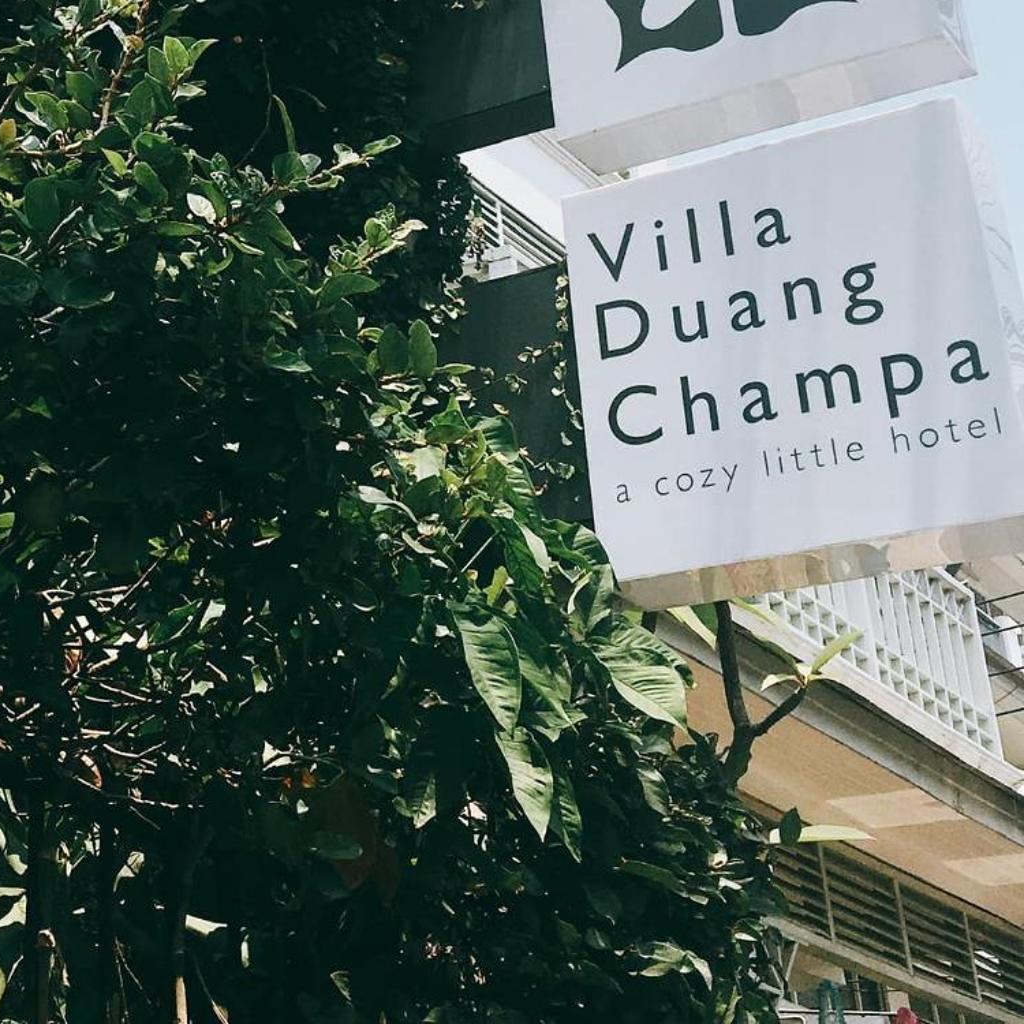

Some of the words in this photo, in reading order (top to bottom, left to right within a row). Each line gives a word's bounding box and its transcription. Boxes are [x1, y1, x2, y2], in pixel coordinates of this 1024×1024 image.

[587, 199, 792, 283] Villa
[594, 261, 885, 361] Duang
[607, 339, 990, 446] Champa
[615, 483, 631, 504] a
[654, 463, 739, 497] cozy
[762, 437, 866, 477] little
[890, 406, 1003, 454] hotel
